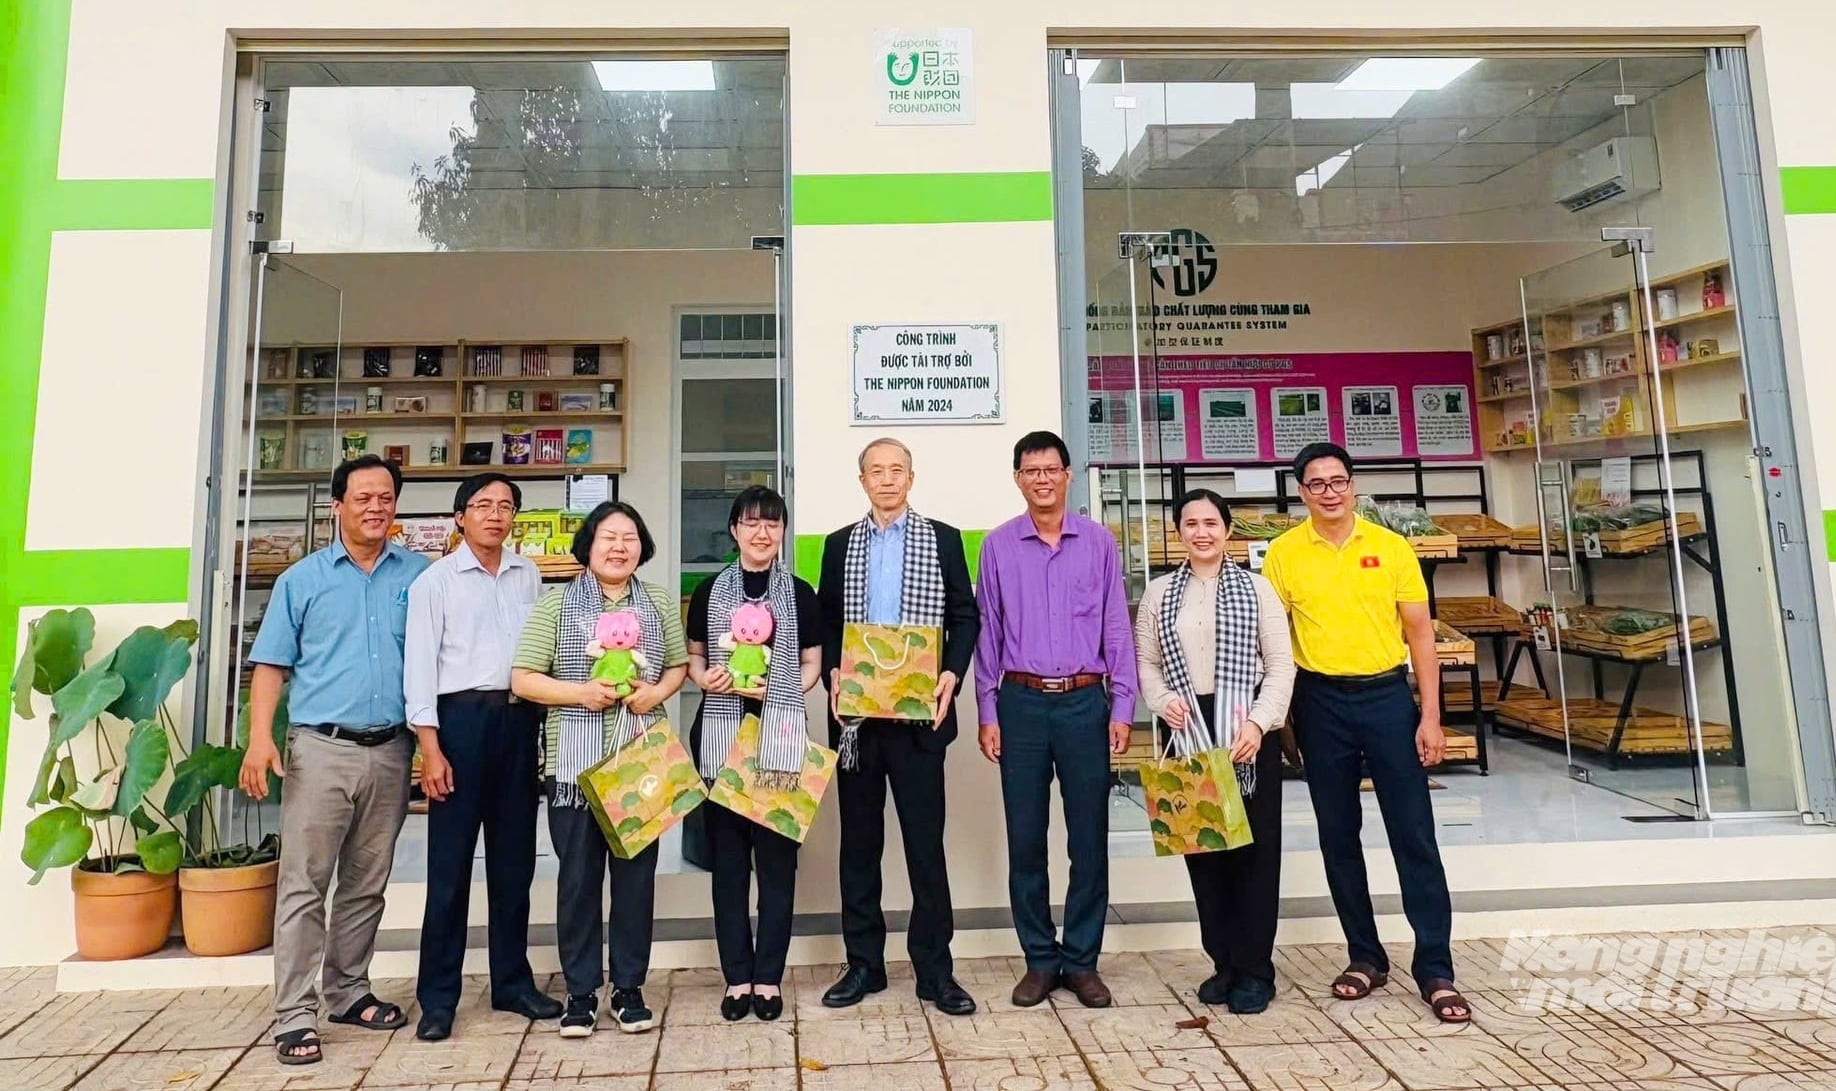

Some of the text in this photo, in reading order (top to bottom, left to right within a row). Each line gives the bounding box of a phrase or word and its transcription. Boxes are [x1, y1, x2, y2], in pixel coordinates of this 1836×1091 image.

[888, 38, 942, 49] upported
[889, 90, 961, 100] THE NIPPON
[888, 103, 961, 113] FOUNDATION
[1163, 302, 1190, 316] CHẤT
[1193, 304, 1227, 319] LƯỢNG
[1229, 302, 1258, 316] CÙNG
[1260, 303, 1290, 315] THAM
[1293, 303, 1311, 315] GIA
[1246, 320, 1288, 330] SYSTEM
[896, 330, 956, 346] CÔNG TRÌNH
[881, 350, 972, 370] ĐƯỢC TÀI TRỢ BỞI
[864, 376, 990, 390] THE NIPPON FOUNDATION
[902, 397, 953, 412] NĂM 2024
